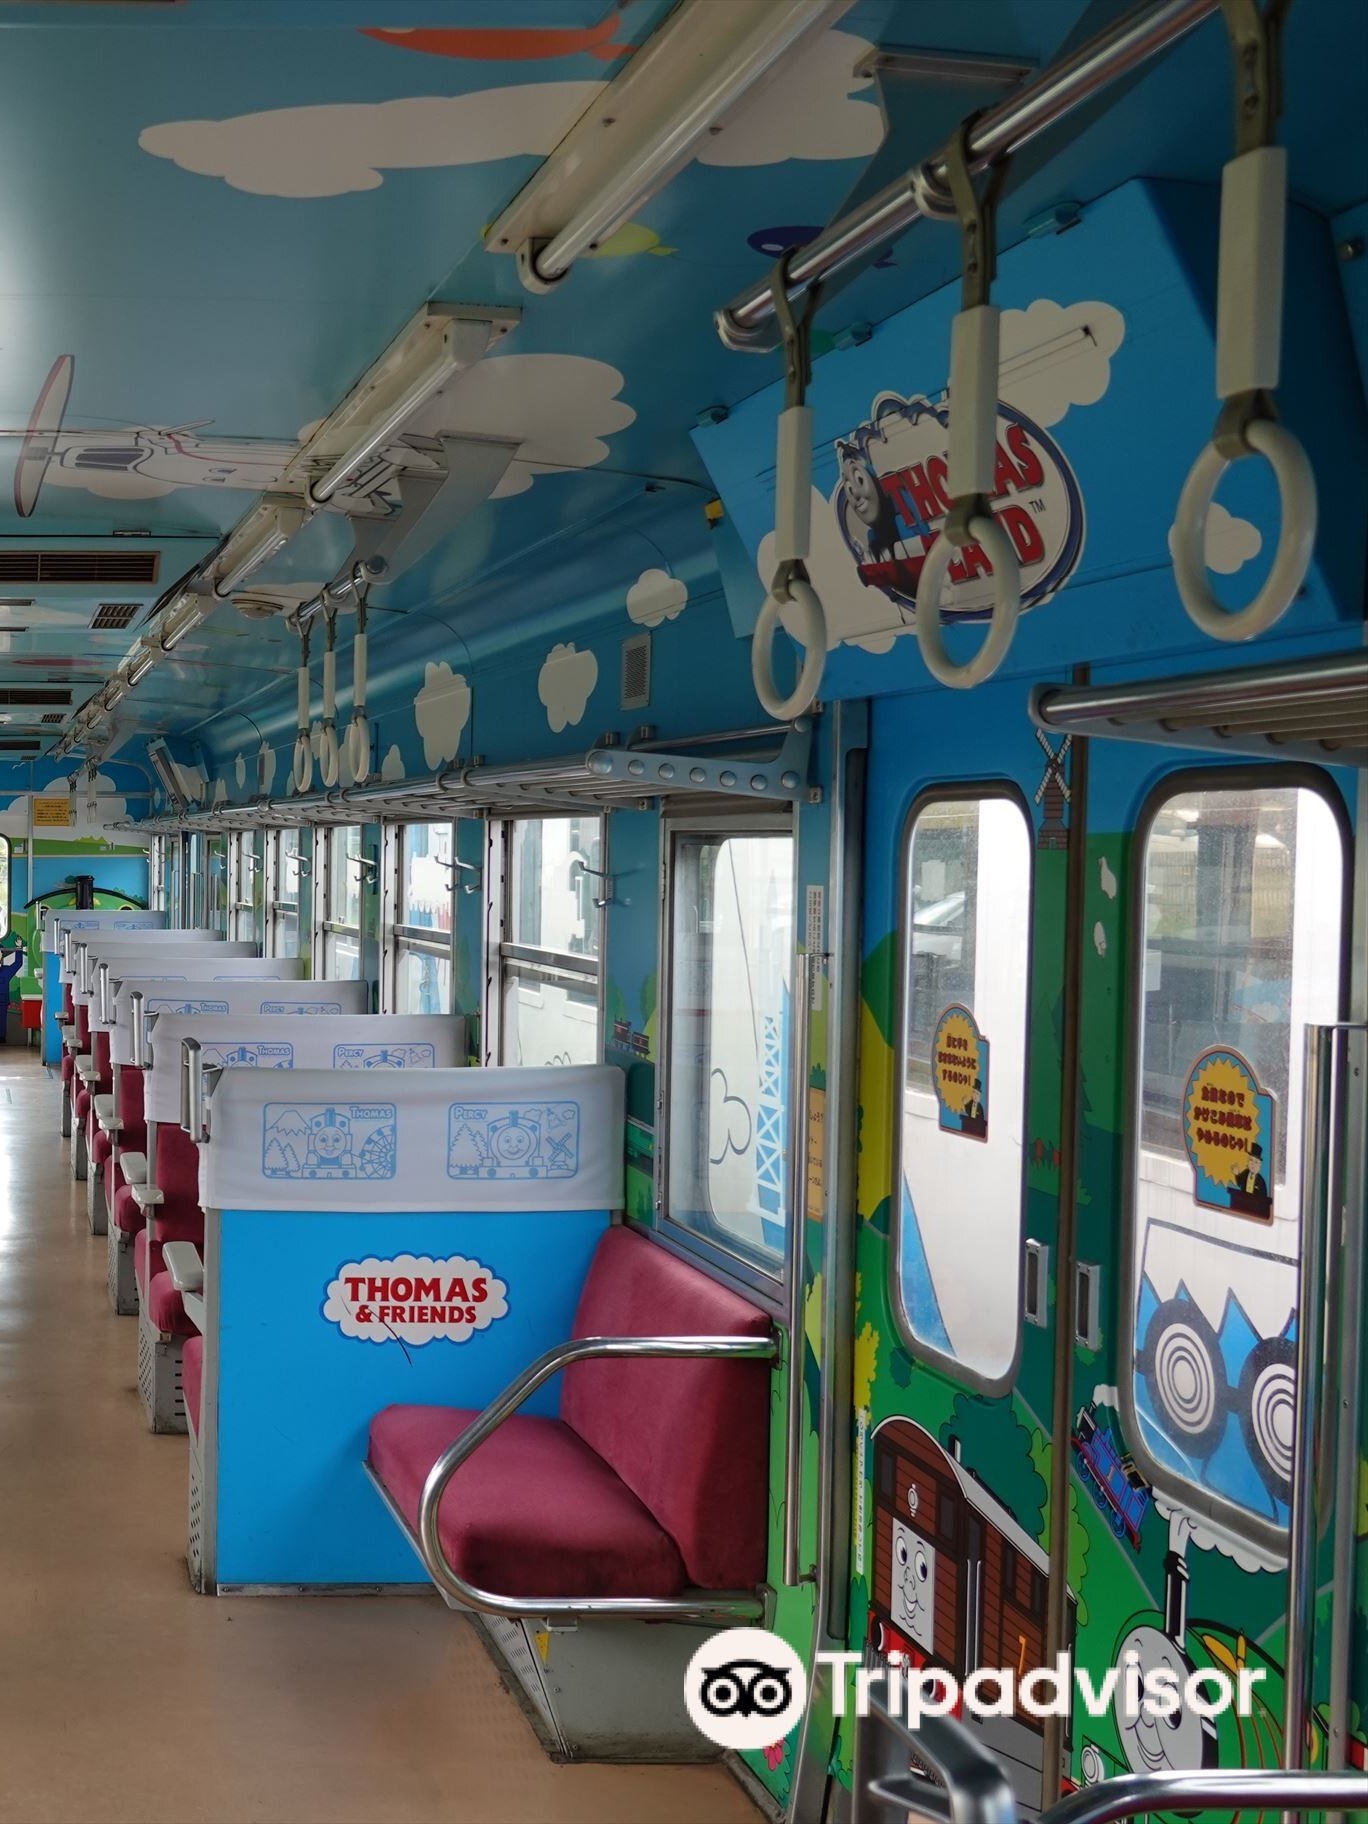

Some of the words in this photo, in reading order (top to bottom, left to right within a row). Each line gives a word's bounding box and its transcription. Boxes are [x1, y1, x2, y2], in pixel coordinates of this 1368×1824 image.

[880, 424, 1044, 527] THOAS
[1029, 499, 1046, 514] TM
[257, 1045, 291, 1055] THOMAS
[337, 1047, 364, 1057] PERCY
[349, 1106, 393, 1120] THOMAS
[454, 1107, 488, 1121] PERCY
[343, 1277, 489, 1303] THOMAS
[355, 1306, 372, 1324] &
[378, 1306, 477, 1324] FRIENDS
